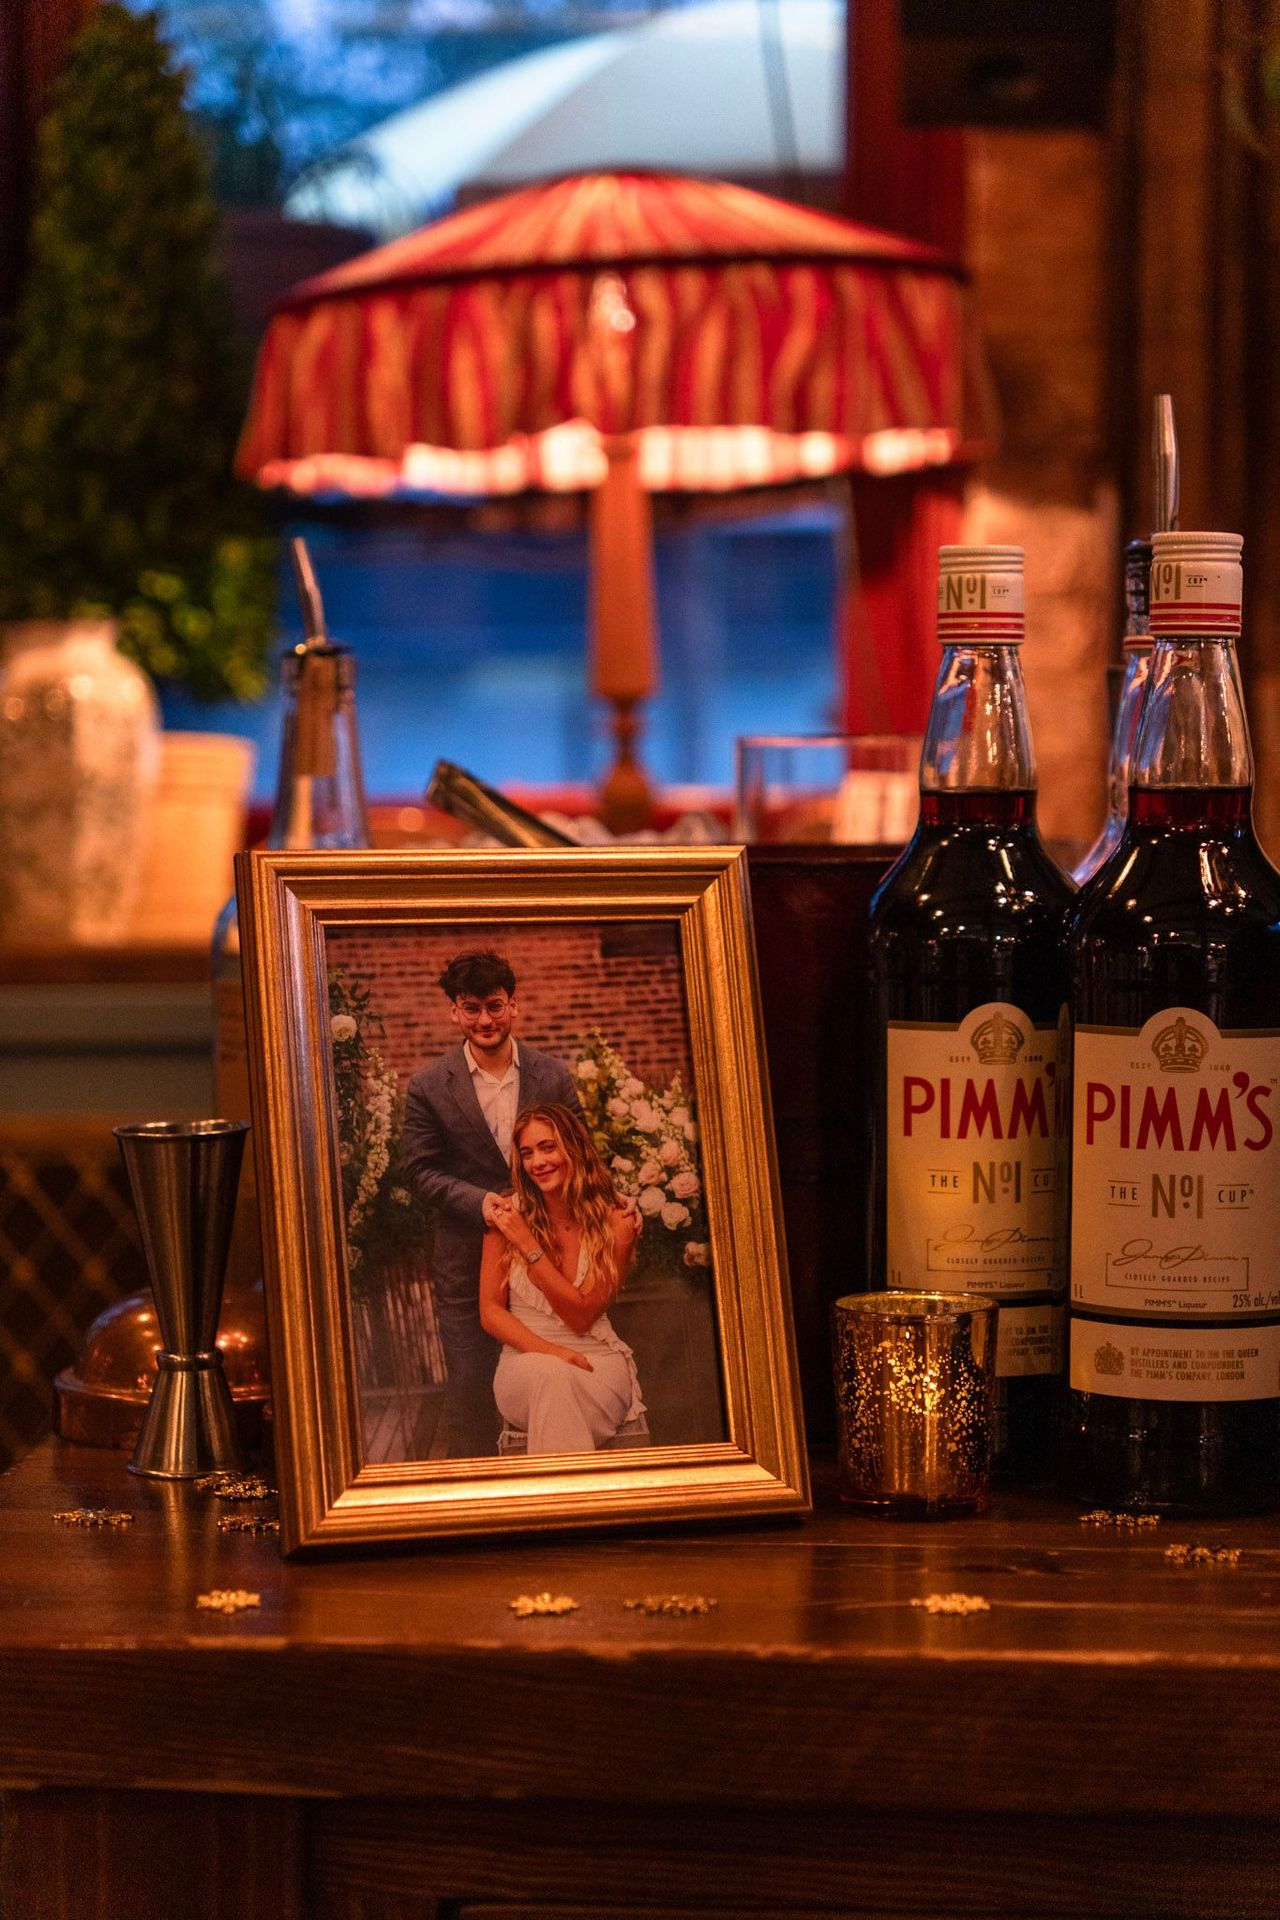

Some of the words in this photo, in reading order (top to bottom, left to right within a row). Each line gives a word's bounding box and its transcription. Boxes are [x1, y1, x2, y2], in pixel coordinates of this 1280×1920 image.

[903, 1062, 1066, 1139] PIMM'
[930, 1174, 959, 1189] THE
[1110, 1185, 1138, 1201] THE
[1124, 1272, 1156, 1282] CLOSELY
[1000, 1280, 1026, 1291] Liqueur
[1178, 1300, 1208, 1310] Liqueur
[1233, 1293, 1251, 1308] 25%
[1142, 1348, 1192, 1359] APPOINTMENT
[1237, 1347, 1259, 1358] QUEEN
[1130, 1358, 1169, 1369] DISTILLERS
[1172, 1360, 1187, 1370] AND
[1190, 1360, 1244, 1370] COMPOUNDERS
[1216, 1371, 1245, 1381] LONDON
